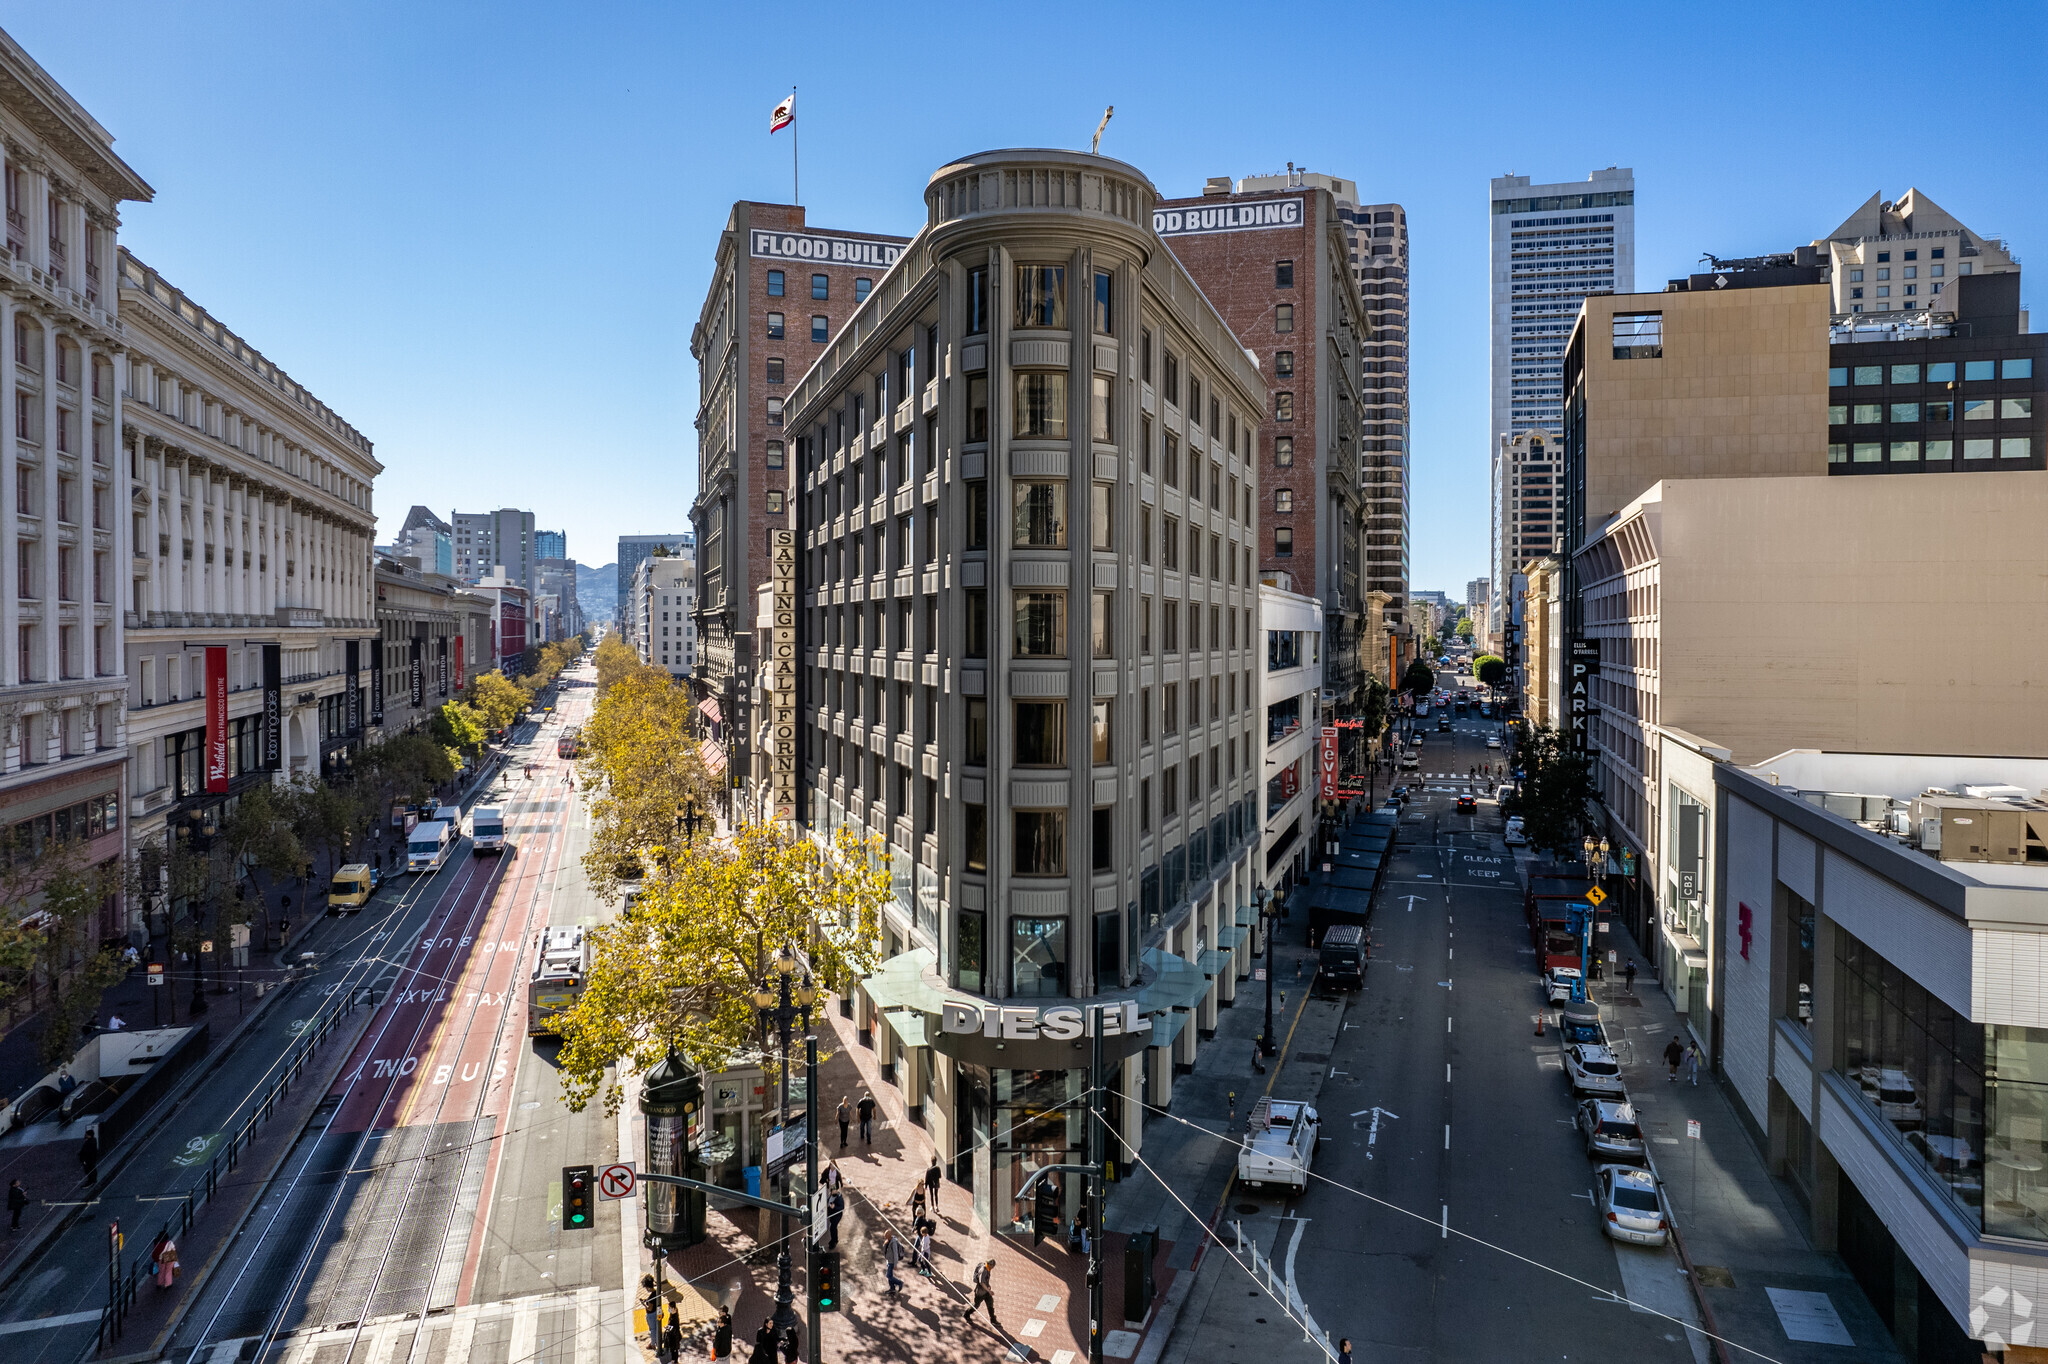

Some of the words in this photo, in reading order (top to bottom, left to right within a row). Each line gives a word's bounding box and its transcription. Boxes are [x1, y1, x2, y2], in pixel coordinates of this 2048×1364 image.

[1185, 203, 1297, 231] BUILDING
[757, 234, 829, 259] FLOOD
[832, 242, 906, 265] BUILD
[777, 532, 792, 626] SAVING
[412, 659, 420, 702] NORDSTROM
[737, 665, 748, 746] OAKLEY
[1573, 663, 1587, 762] PARKIN
[777, 644, 792, 803] CALIFORNIA
[1348, 718, 1364, 730] Grill
[210, 741, 226, 781] Westfield
[1463, 855, 1502, 864] CLEAR
[1468, 869, 1500, 878] KEEP
[1683, 875, 1693, 896] CB2
[421, 935, 473, 950] BUS
[483, 941, 536, 953] ONLY
[396, 987, 447, 1004] TAXI
[465, 991, 518, 1008] TAXI
[942, 1000, 1152, 1041] DIESEL
[344, 1056, 418, 1082] ONLY
[432, 1060, 509, 1085] BUS
[647, 1106, 677, 1114] FRANCISCO
